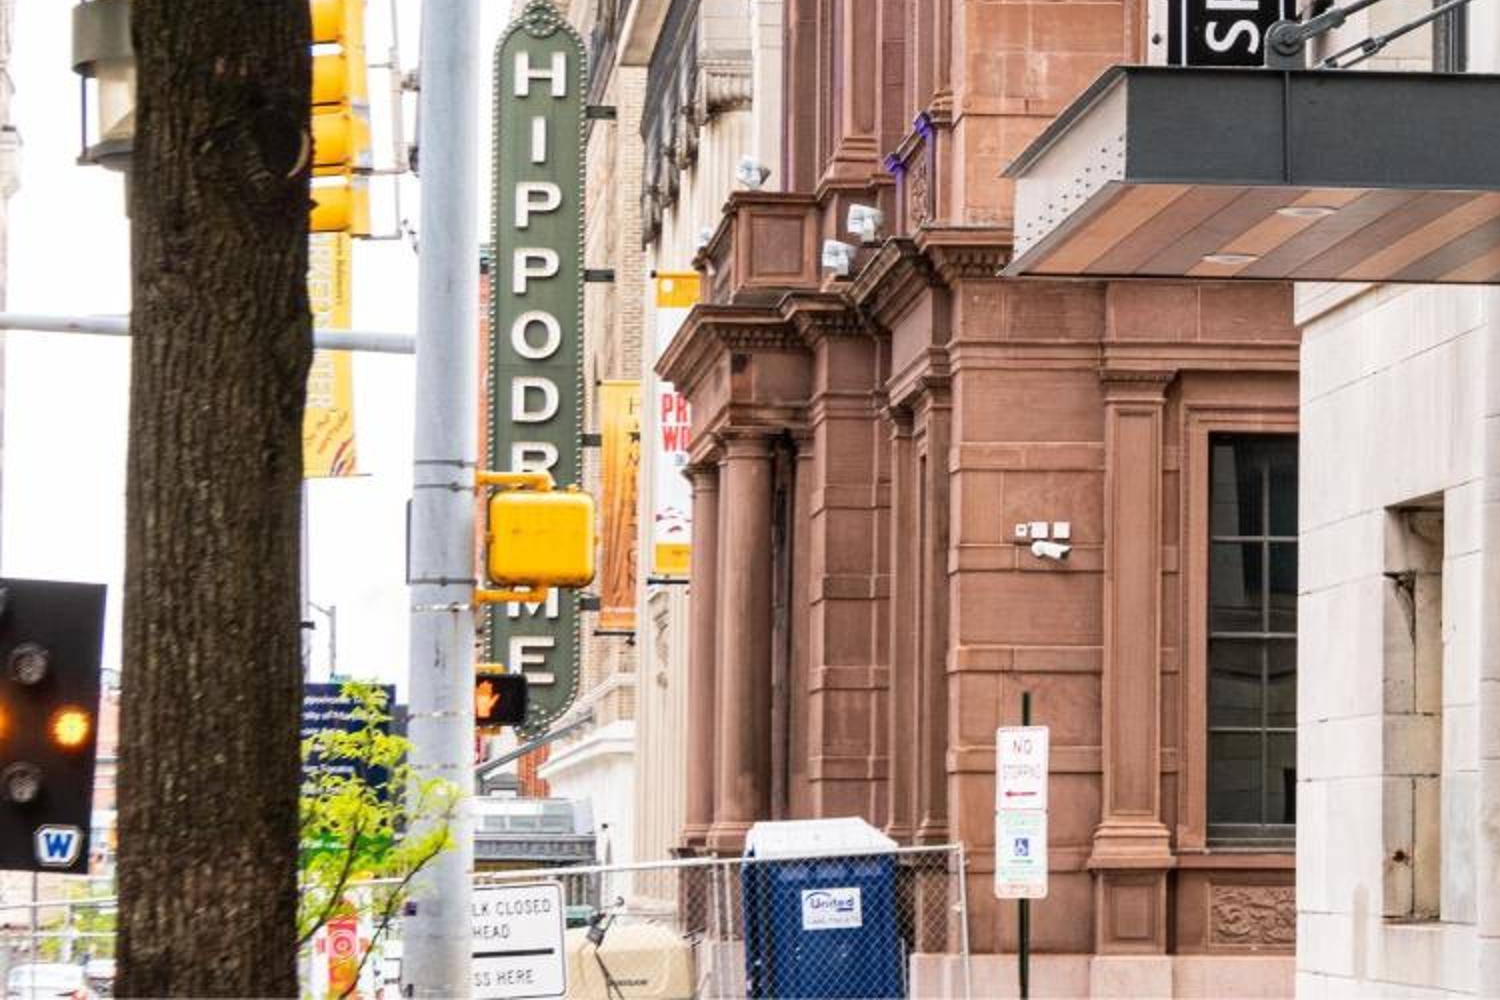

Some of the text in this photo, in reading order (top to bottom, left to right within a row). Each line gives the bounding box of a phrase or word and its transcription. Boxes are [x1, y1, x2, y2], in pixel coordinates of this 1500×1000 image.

[507, 51, 567, 685] HIPPODRME
[1012, 738, 1034, 755] NO
[44, 833, 73, 859] W
[496, 898, 551, 916] CLOSED
[497, 968, 535, 985] HERE
